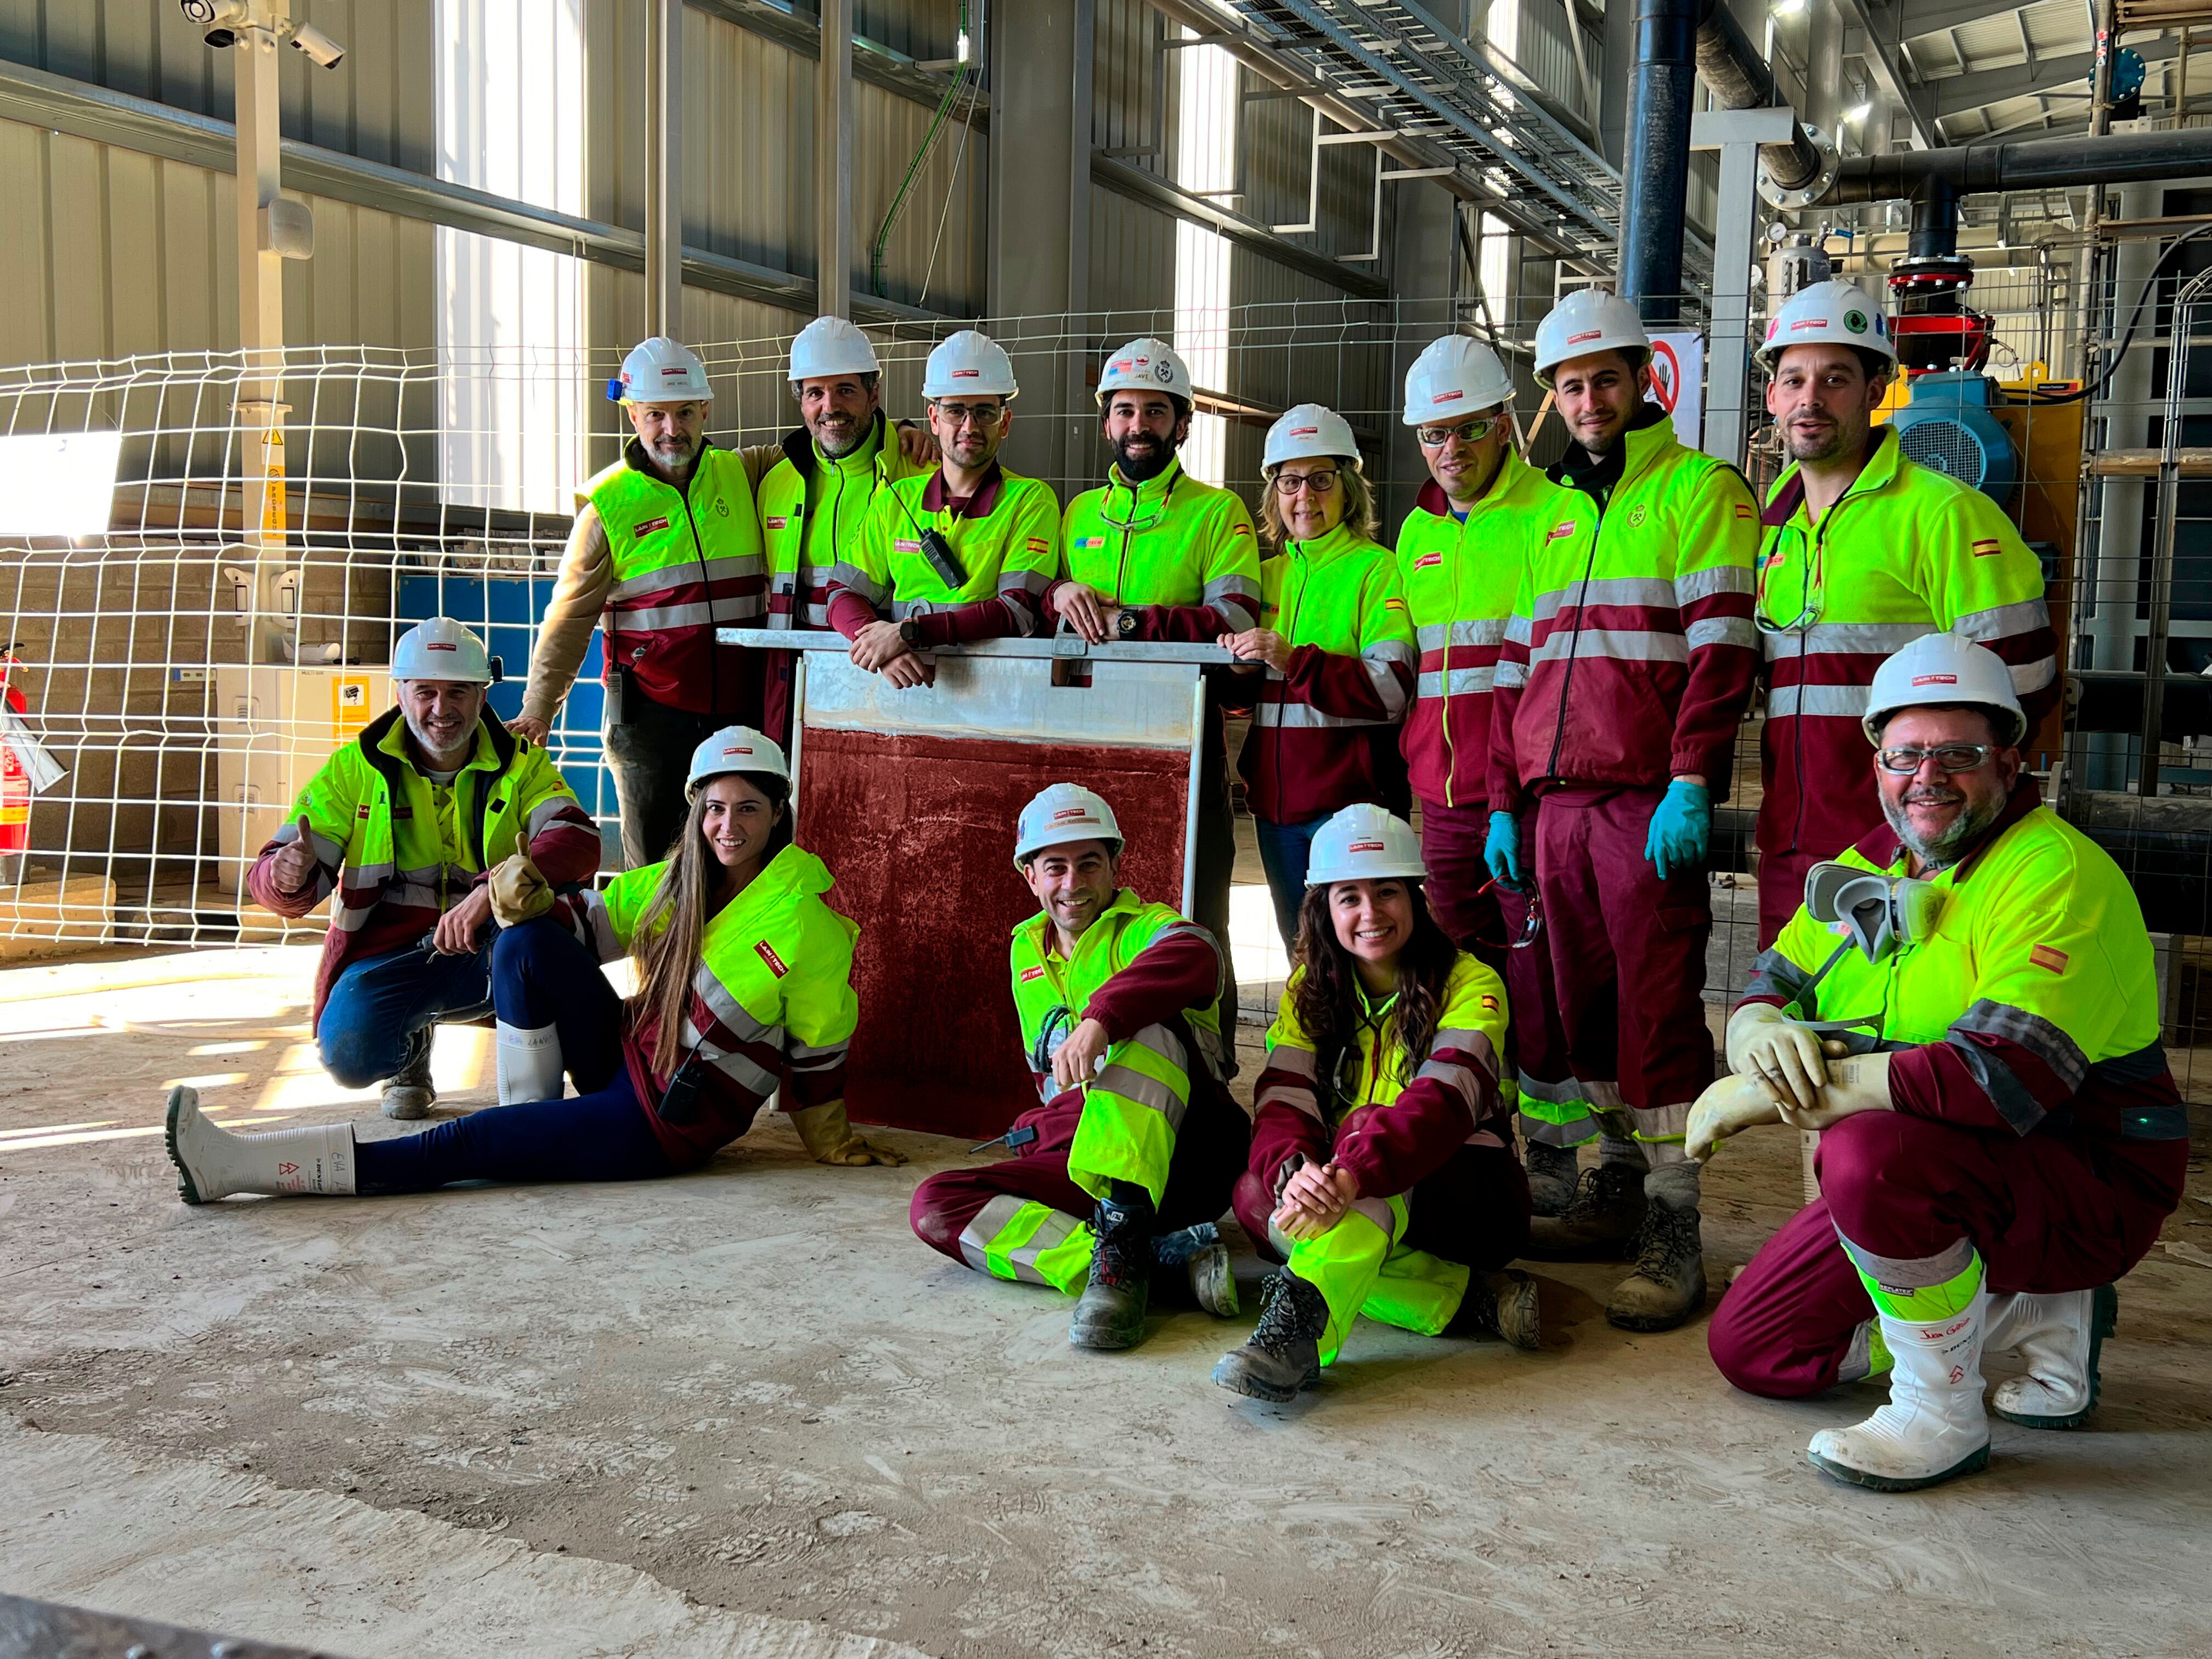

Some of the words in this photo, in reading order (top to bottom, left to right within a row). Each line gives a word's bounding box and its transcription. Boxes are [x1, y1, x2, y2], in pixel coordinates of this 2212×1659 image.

[651, 518, 668, 527] TECH
[1558, 523, 1574, 531] TECH
[759, 941, 772, 957] LAIN
[772, 957, 786, 974] TECH
[331, 1152, 345, 1172] EVA
